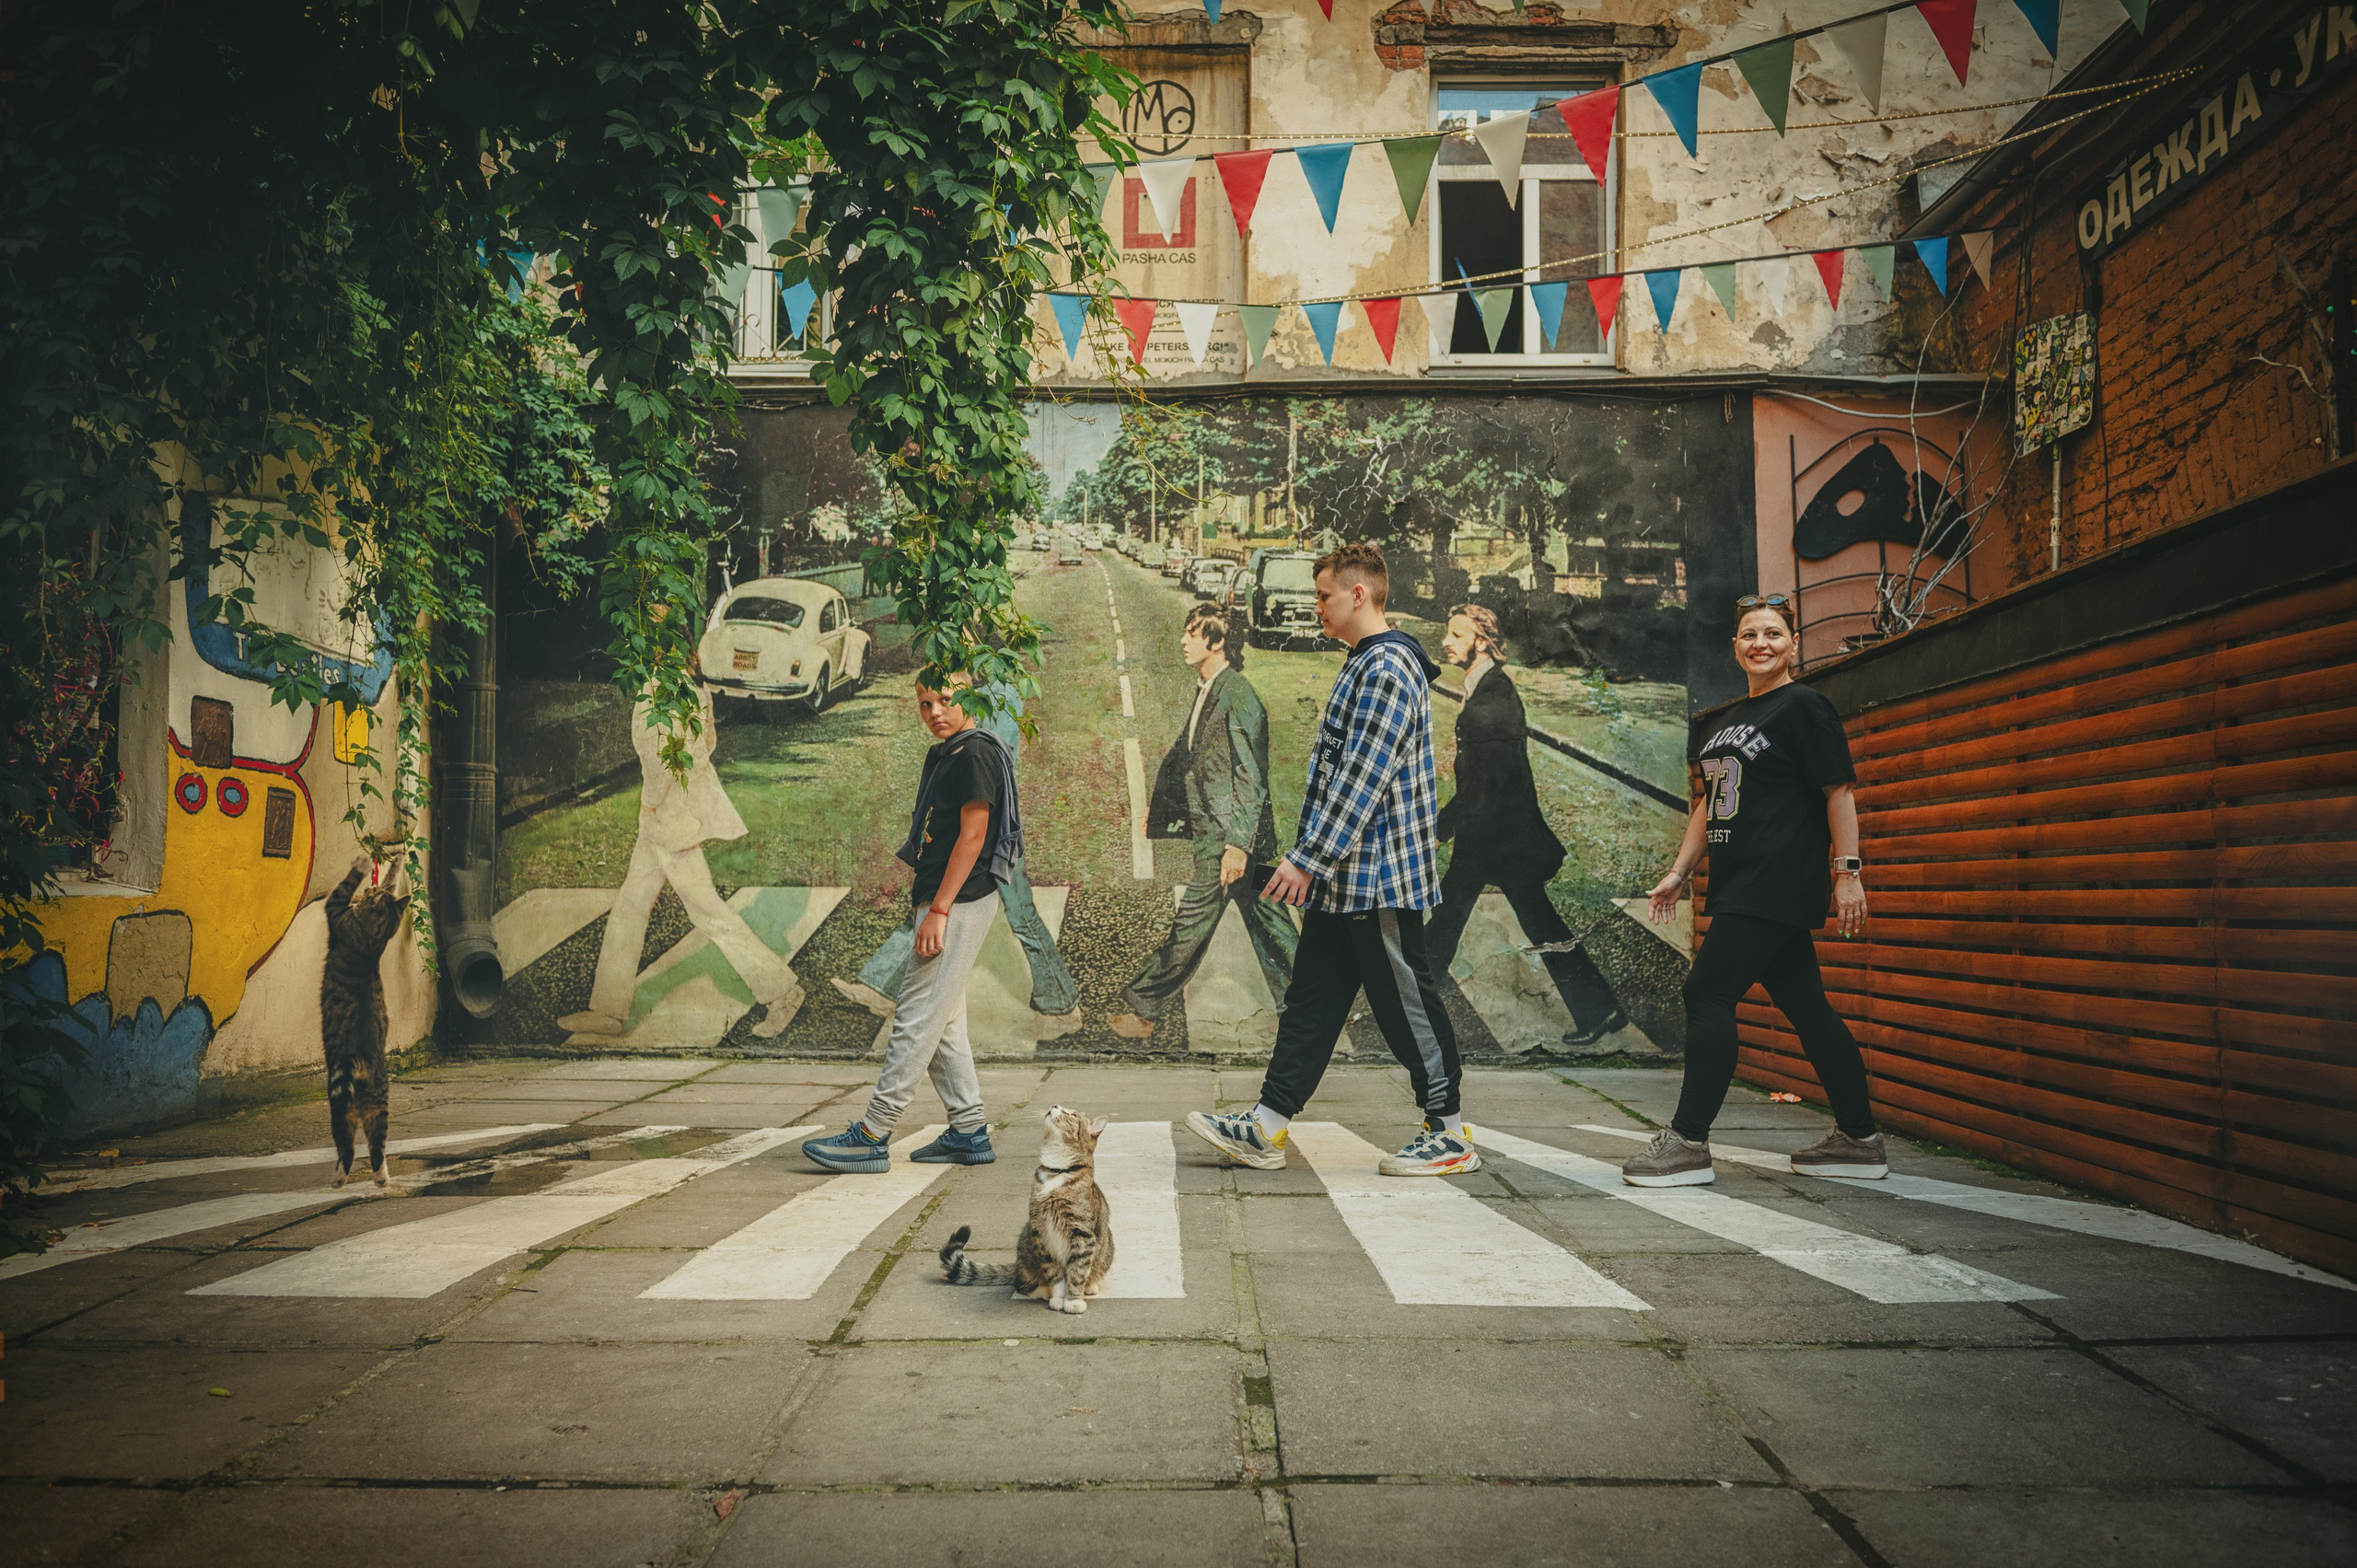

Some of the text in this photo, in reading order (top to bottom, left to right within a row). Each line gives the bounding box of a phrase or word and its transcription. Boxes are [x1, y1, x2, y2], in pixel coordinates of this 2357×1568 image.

[2077, 71, 2264, 250] ОДЕЖДА
[1122, 252, 1197, 265] PASHA CAS
[1146, 342, 1229, 351] PETERSRG!"
[1154, 355, 1183, 364] MOKICH
[1184, 355, 1209, 364] PAA
[1701, 756, 1743, 821] 73
